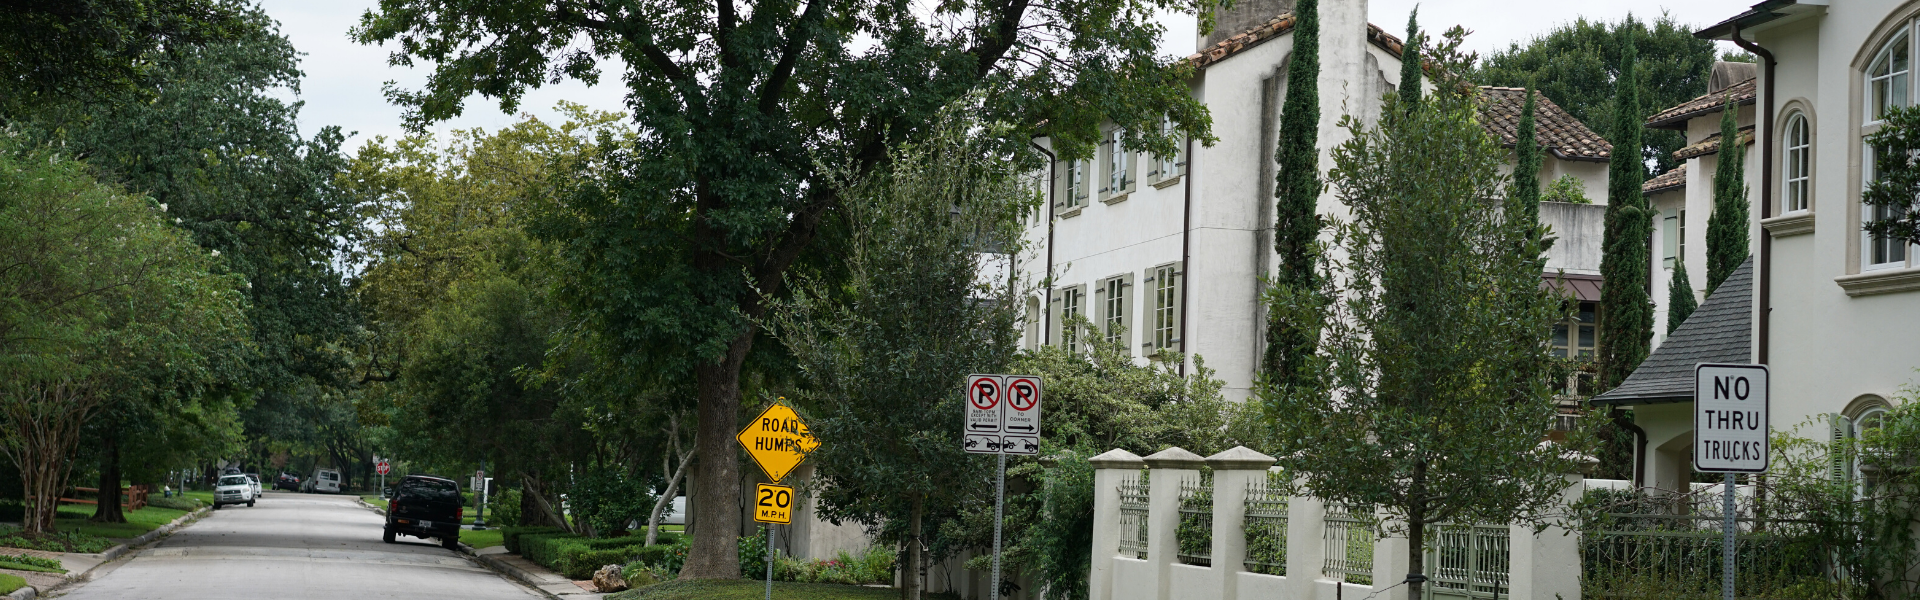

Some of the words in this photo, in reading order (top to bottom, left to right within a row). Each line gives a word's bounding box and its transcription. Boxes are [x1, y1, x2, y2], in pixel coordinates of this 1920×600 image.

[1714, 376, 1750, 400] NO
[762, 418, 798, 433] ROAD
[1705, 410, 1758, 430] THRU
[755, 437, 802, 452] HUMPS
[1704, 440, 1760, 460] TRUCKS
[759, 489, 790, 508] 20
[762, 510, 786, 519] M.P.H.
